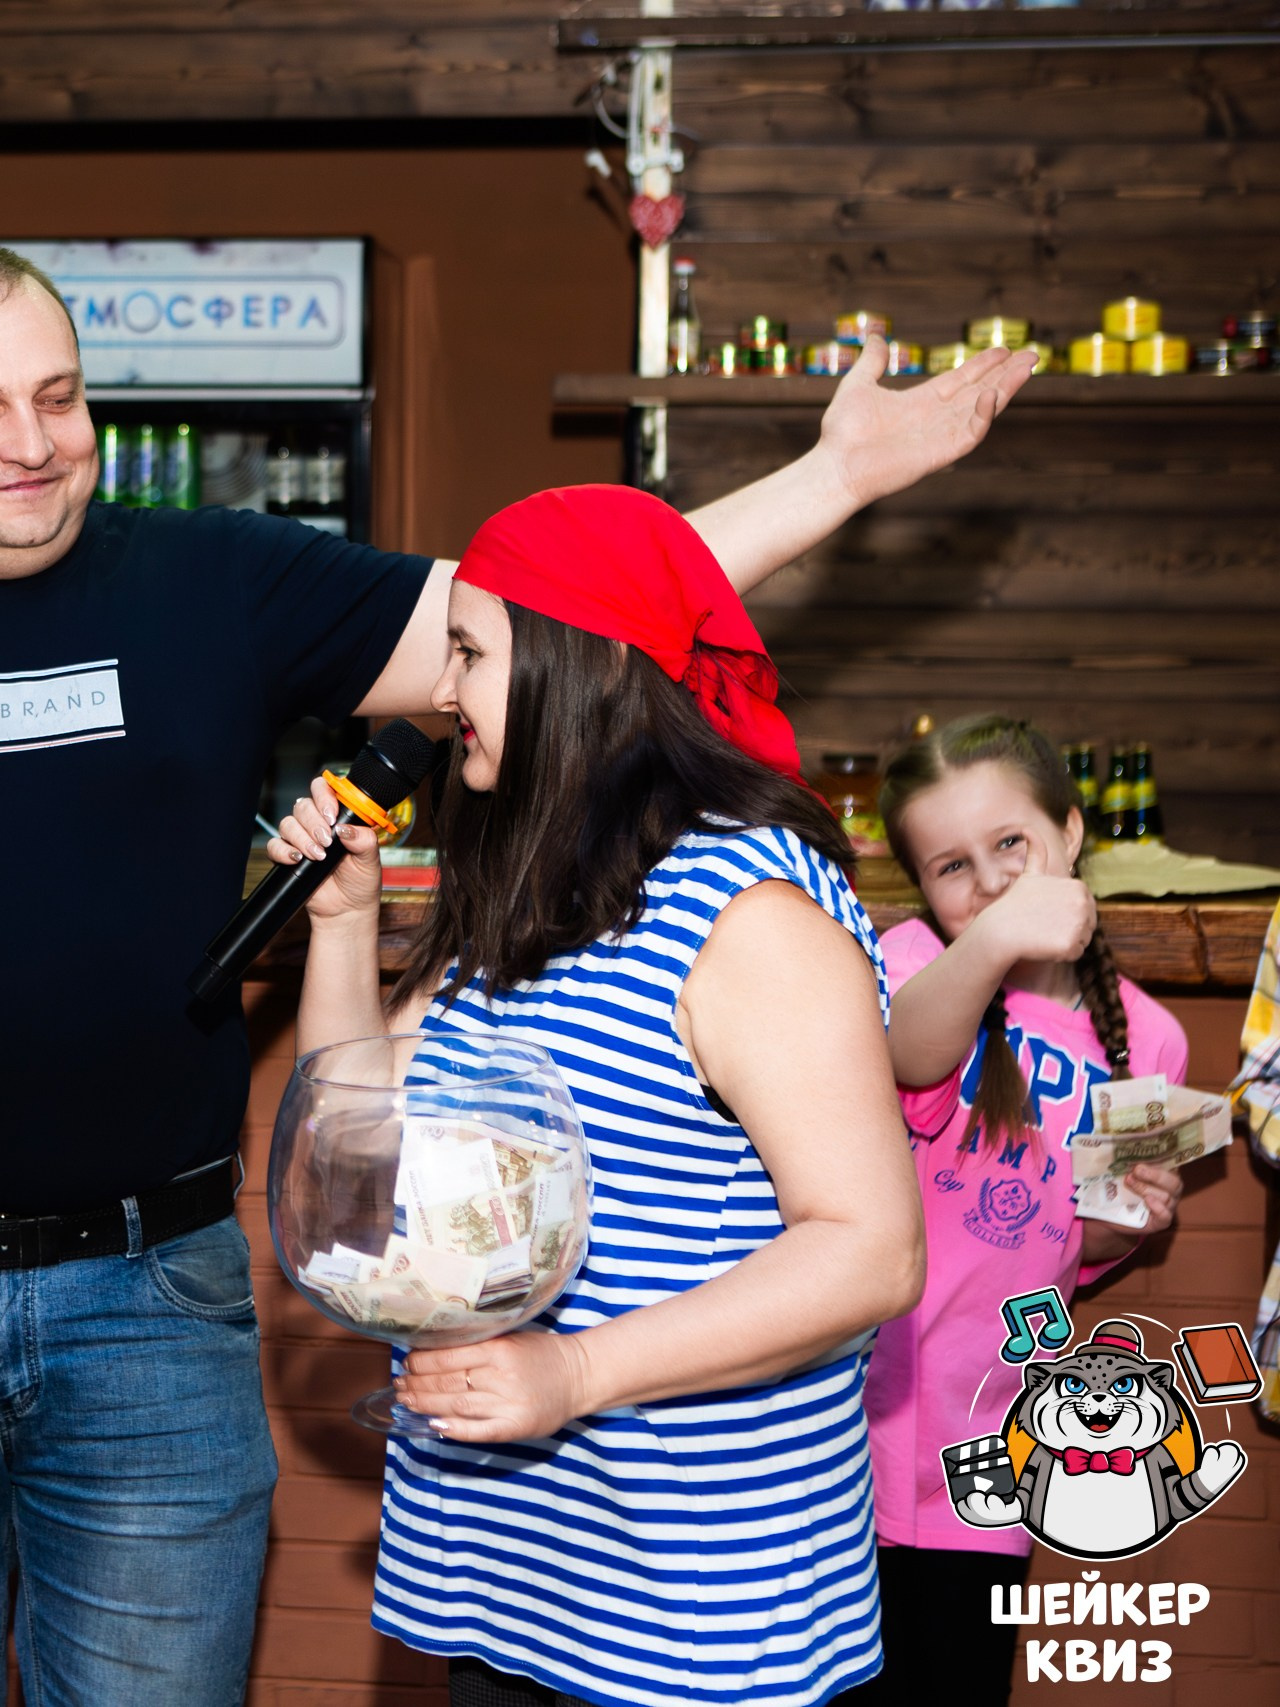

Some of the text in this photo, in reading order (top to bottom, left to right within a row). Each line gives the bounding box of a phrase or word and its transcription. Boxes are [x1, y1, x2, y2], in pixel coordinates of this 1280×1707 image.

[1, 690, 106, 719] BRAND
[908, 1126, 1058, 1183] AMP
[1040, 1221, 1067, 1244] 199
